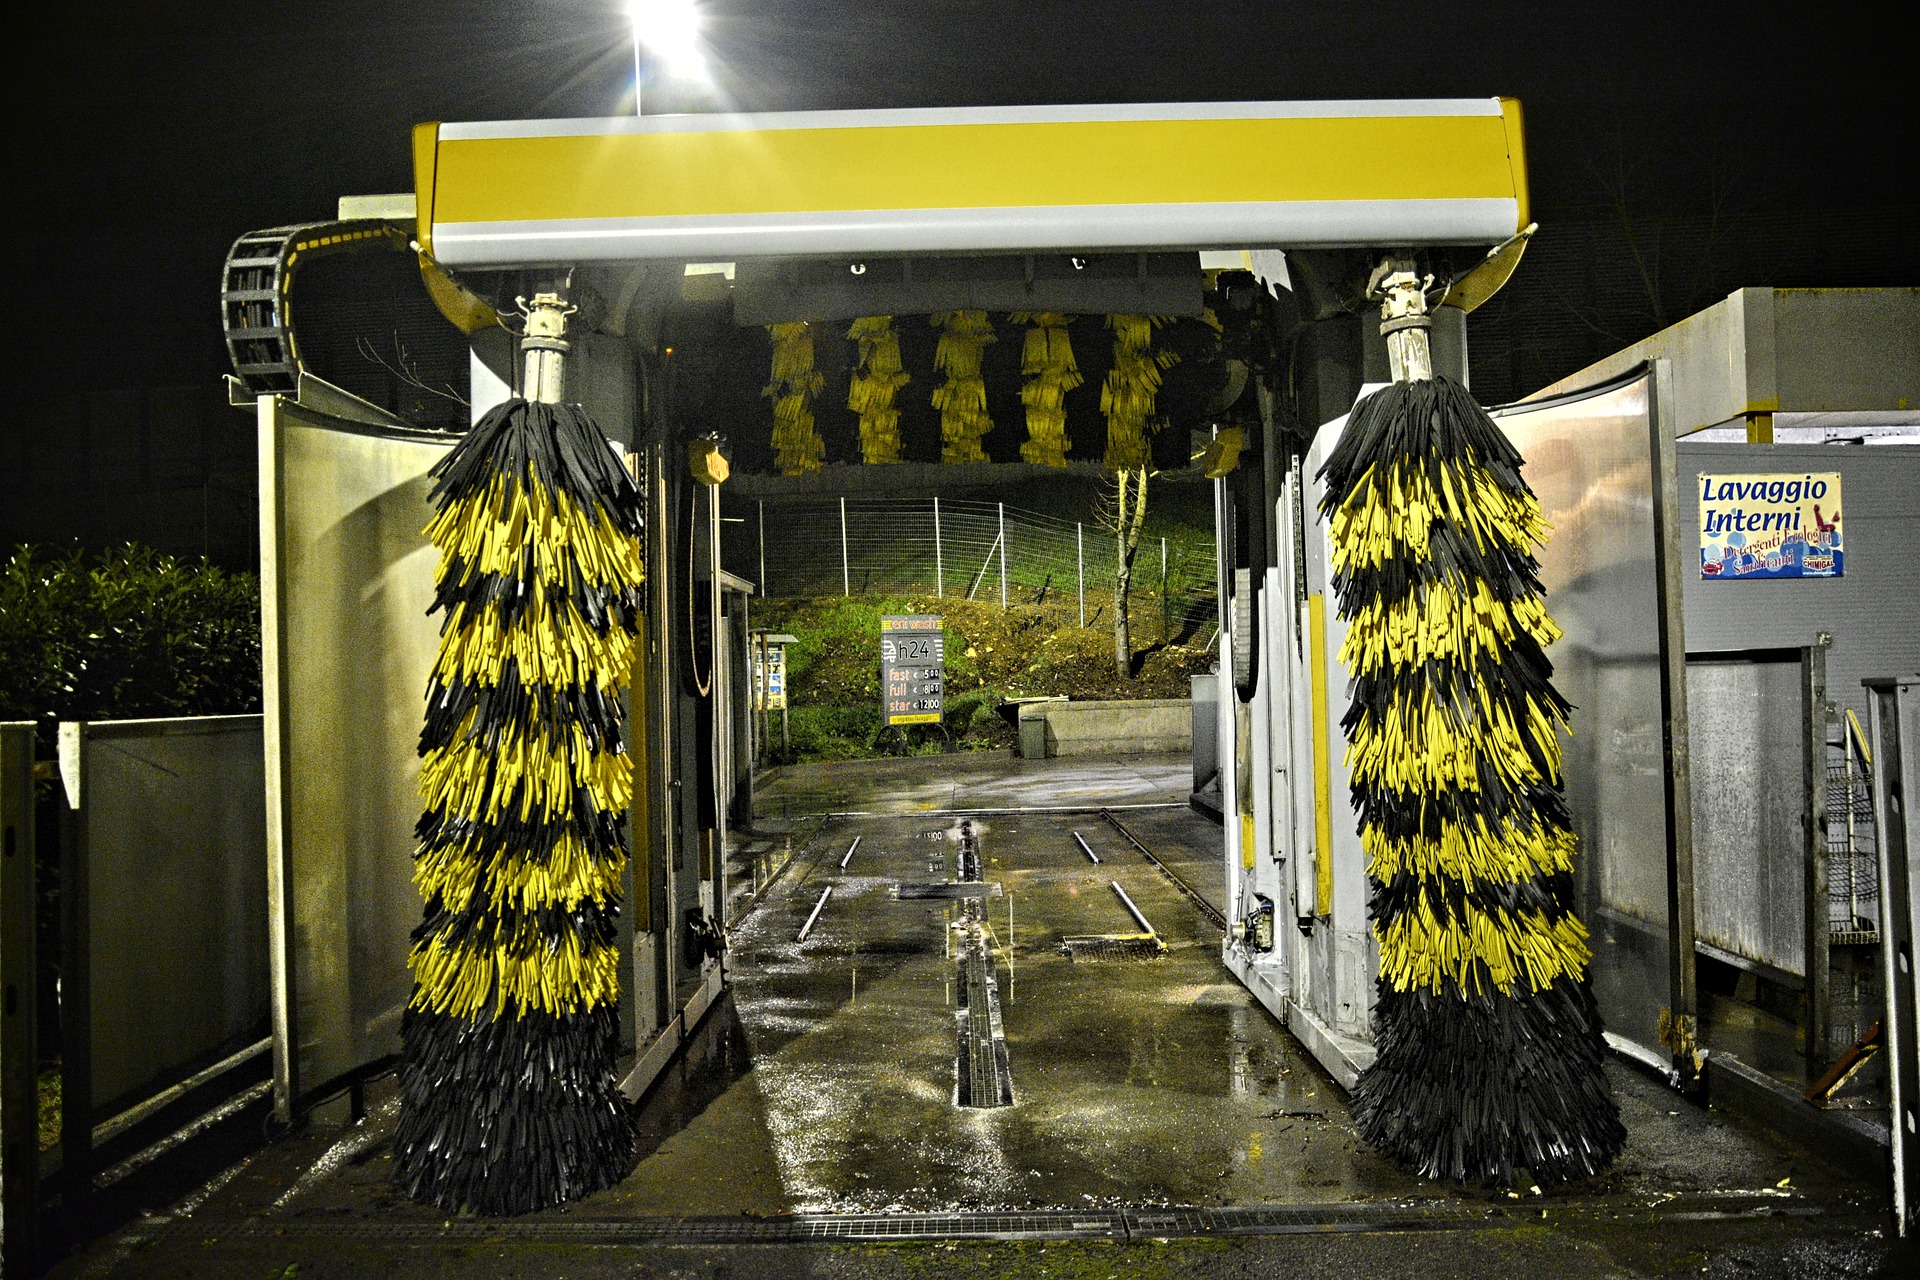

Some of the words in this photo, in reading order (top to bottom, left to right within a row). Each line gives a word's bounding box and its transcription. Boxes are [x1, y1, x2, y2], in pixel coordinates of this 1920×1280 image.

[1703, 475, 1827, 504] Lavaggio
[1703, 506, 1801, 532] Interni
[1724, 532, 1780, 559] Detergenti
[1784, 524, 1832, 546] Ecologici
[1803, 560, 1834, 570] CHIMIGAL
[892, 617, 908, 630] eni
[909, 617, 936, 630] wash
[899, 640, 930, 659] h24
[889, 668, 910, 681] fast
[889, 683, 907, 697] full
[889, 700, 911, 712] star
